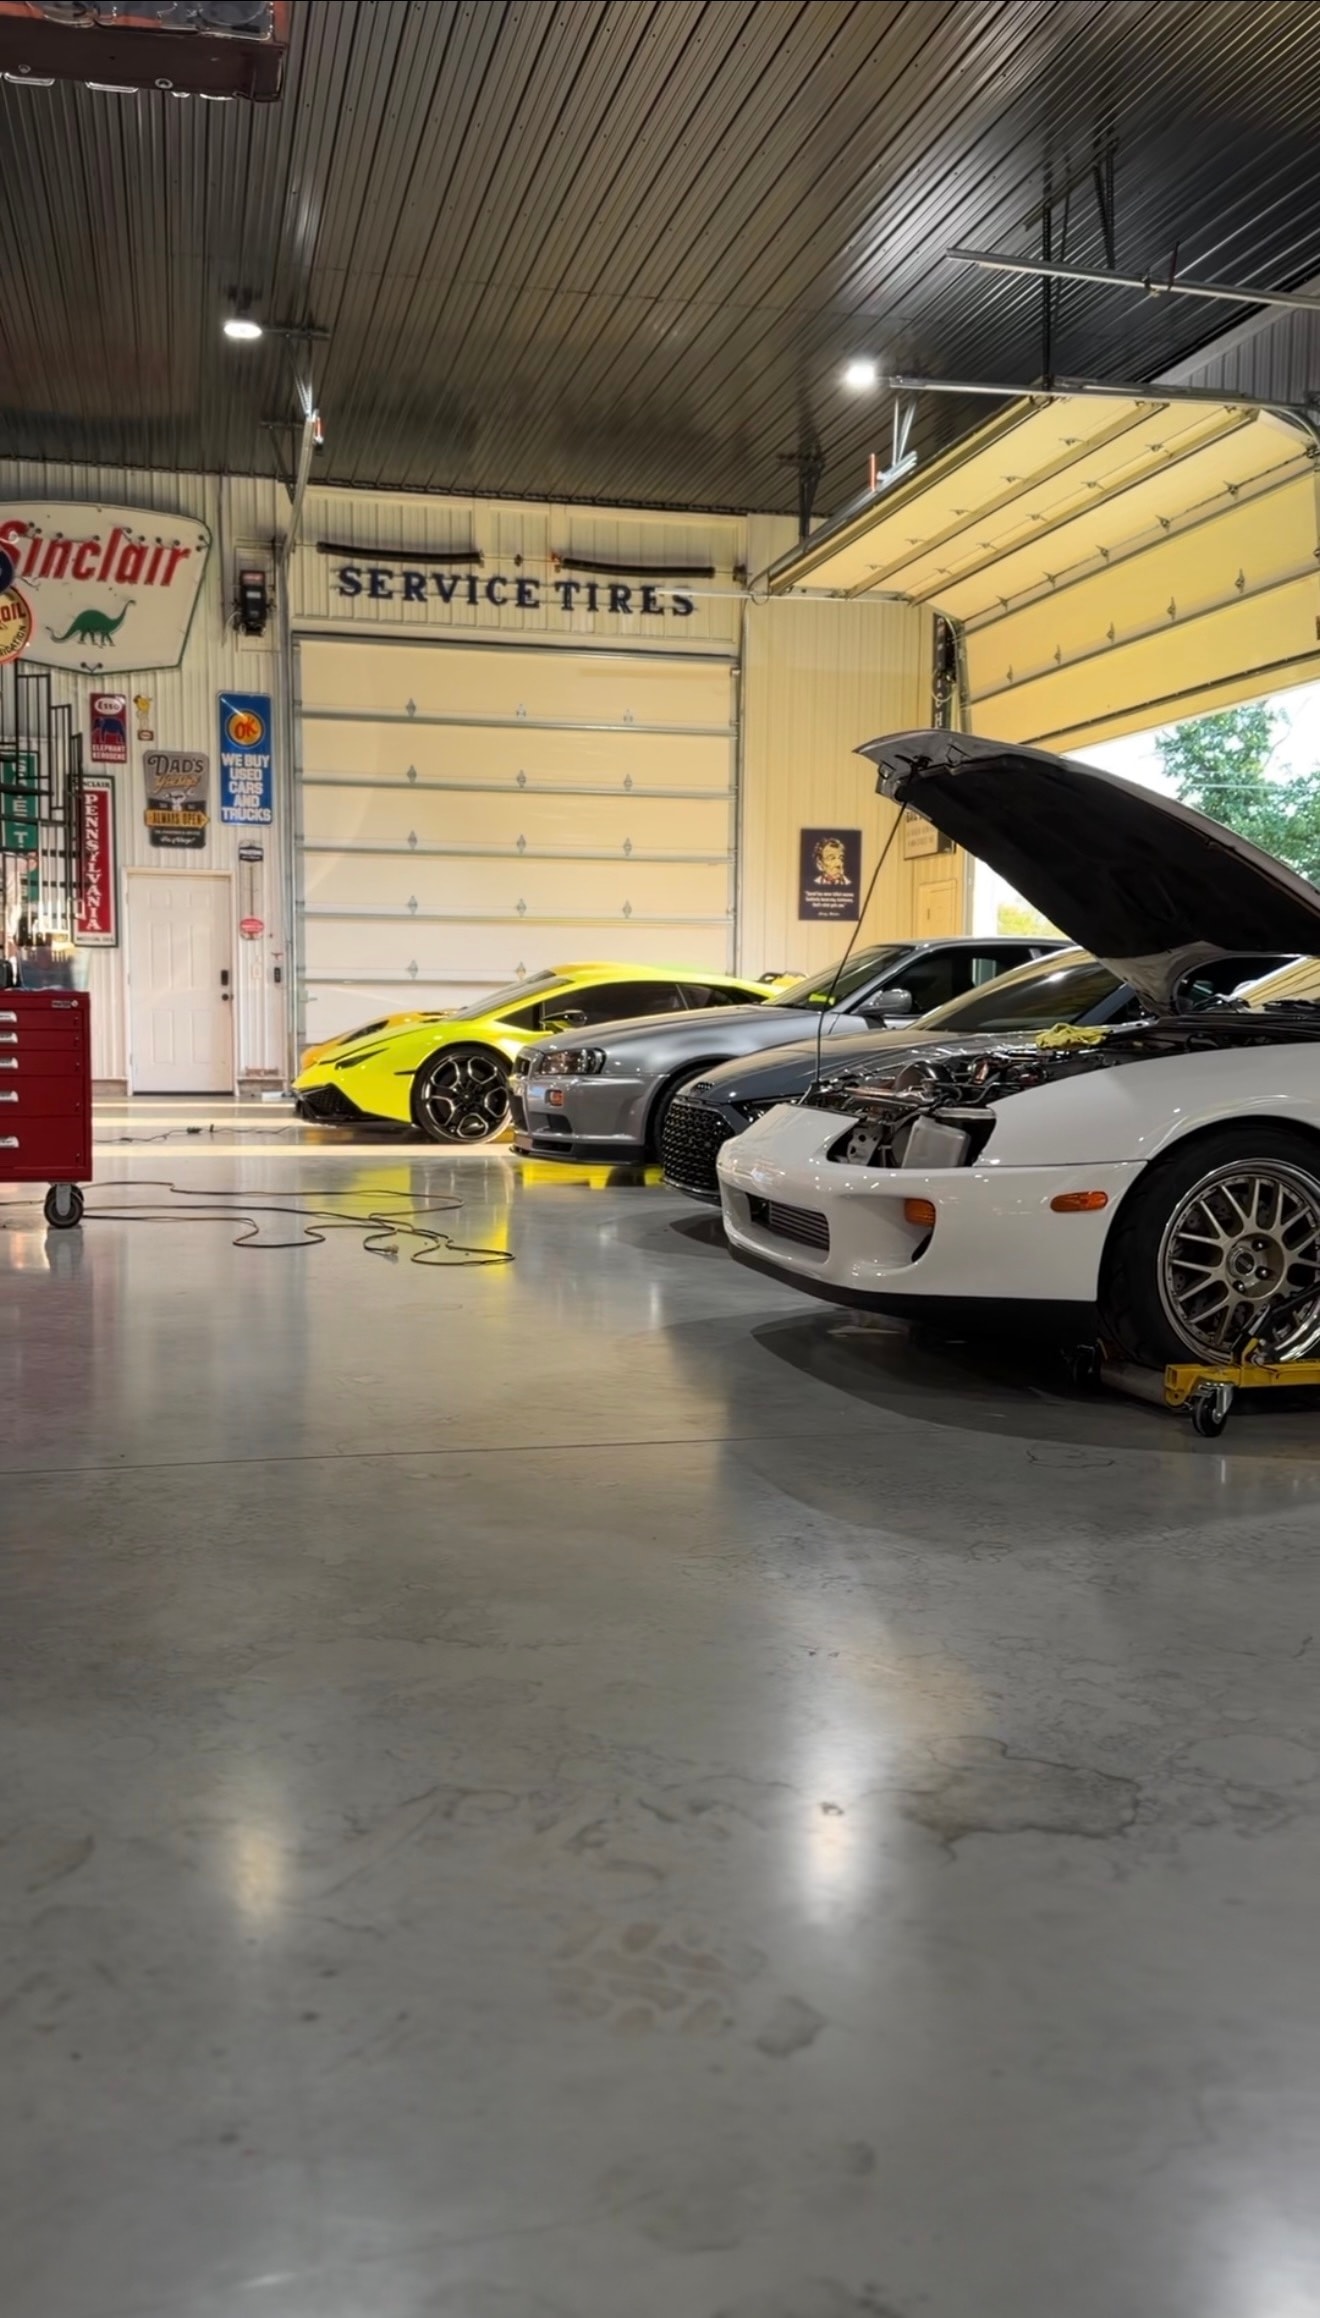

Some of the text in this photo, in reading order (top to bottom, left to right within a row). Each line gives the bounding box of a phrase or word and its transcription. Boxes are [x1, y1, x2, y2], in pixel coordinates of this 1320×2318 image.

[0, 520, 192, 587] Sinclair
[338, 566, 695, 617] SERVICE TIRES
[234, 715, 258, 740] OK
[221, 753, 270, 768] WE BUY
[229, 767, 263, 781] USED
[228, 781, 264, 795] CARS
[233, 794, 260, 808] AND
[182, 812, 202, 826] OPEN
[221, 806, 272, 822] TRUCKS
[85, 794, 102, 930] PENNSYLVANIA
